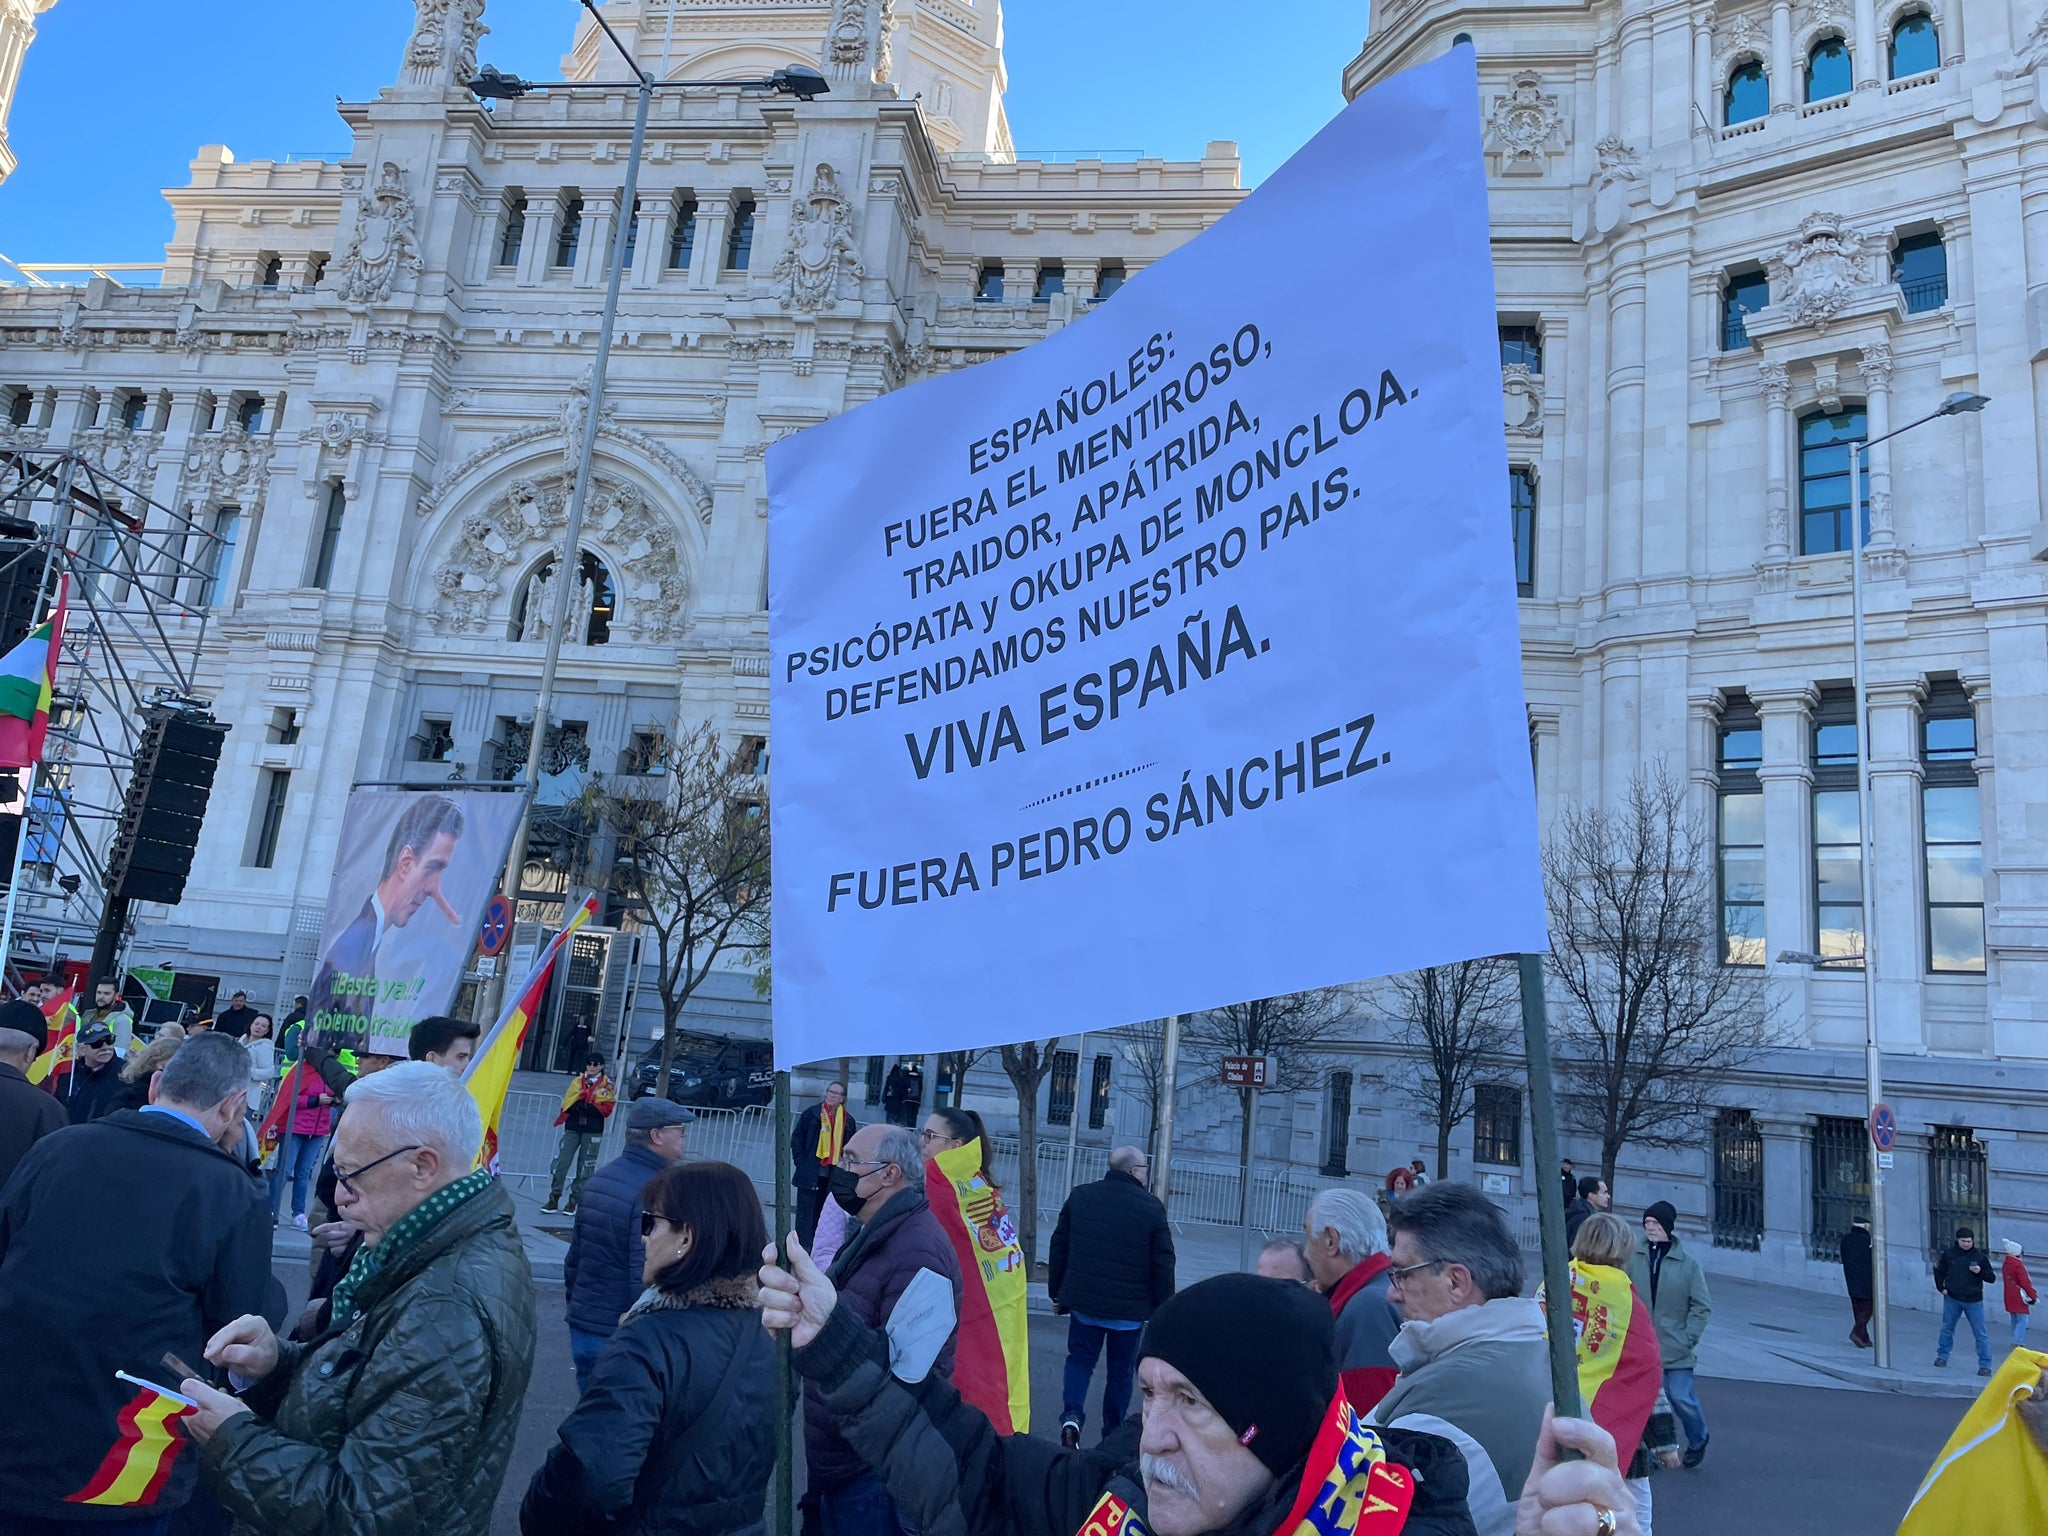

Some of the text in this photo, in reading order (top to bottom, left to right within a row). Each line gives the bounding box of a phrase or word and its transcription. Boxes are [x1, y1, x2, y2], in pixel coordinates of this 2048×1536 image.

[885, 323, 1273, 558] FUERA EL MENTIROSO,
[903, 398, 1261, 600] TRAIDOR, APÁTRIDA,
[970, 330, 1175, 476] ESPAÑOLES:
[787, 368, 1420, 684] PSICÓPATA y OKUPA DE MONCLOA.
[826, 466, 1362, 722] DEFENDAMOS NUESTRO PAIS.
[905, 603, 1272, 780] VIVA ESPAÑA.
[827, 713, 1392, 913] FUERA PEDRO SÁNCHEZ.
